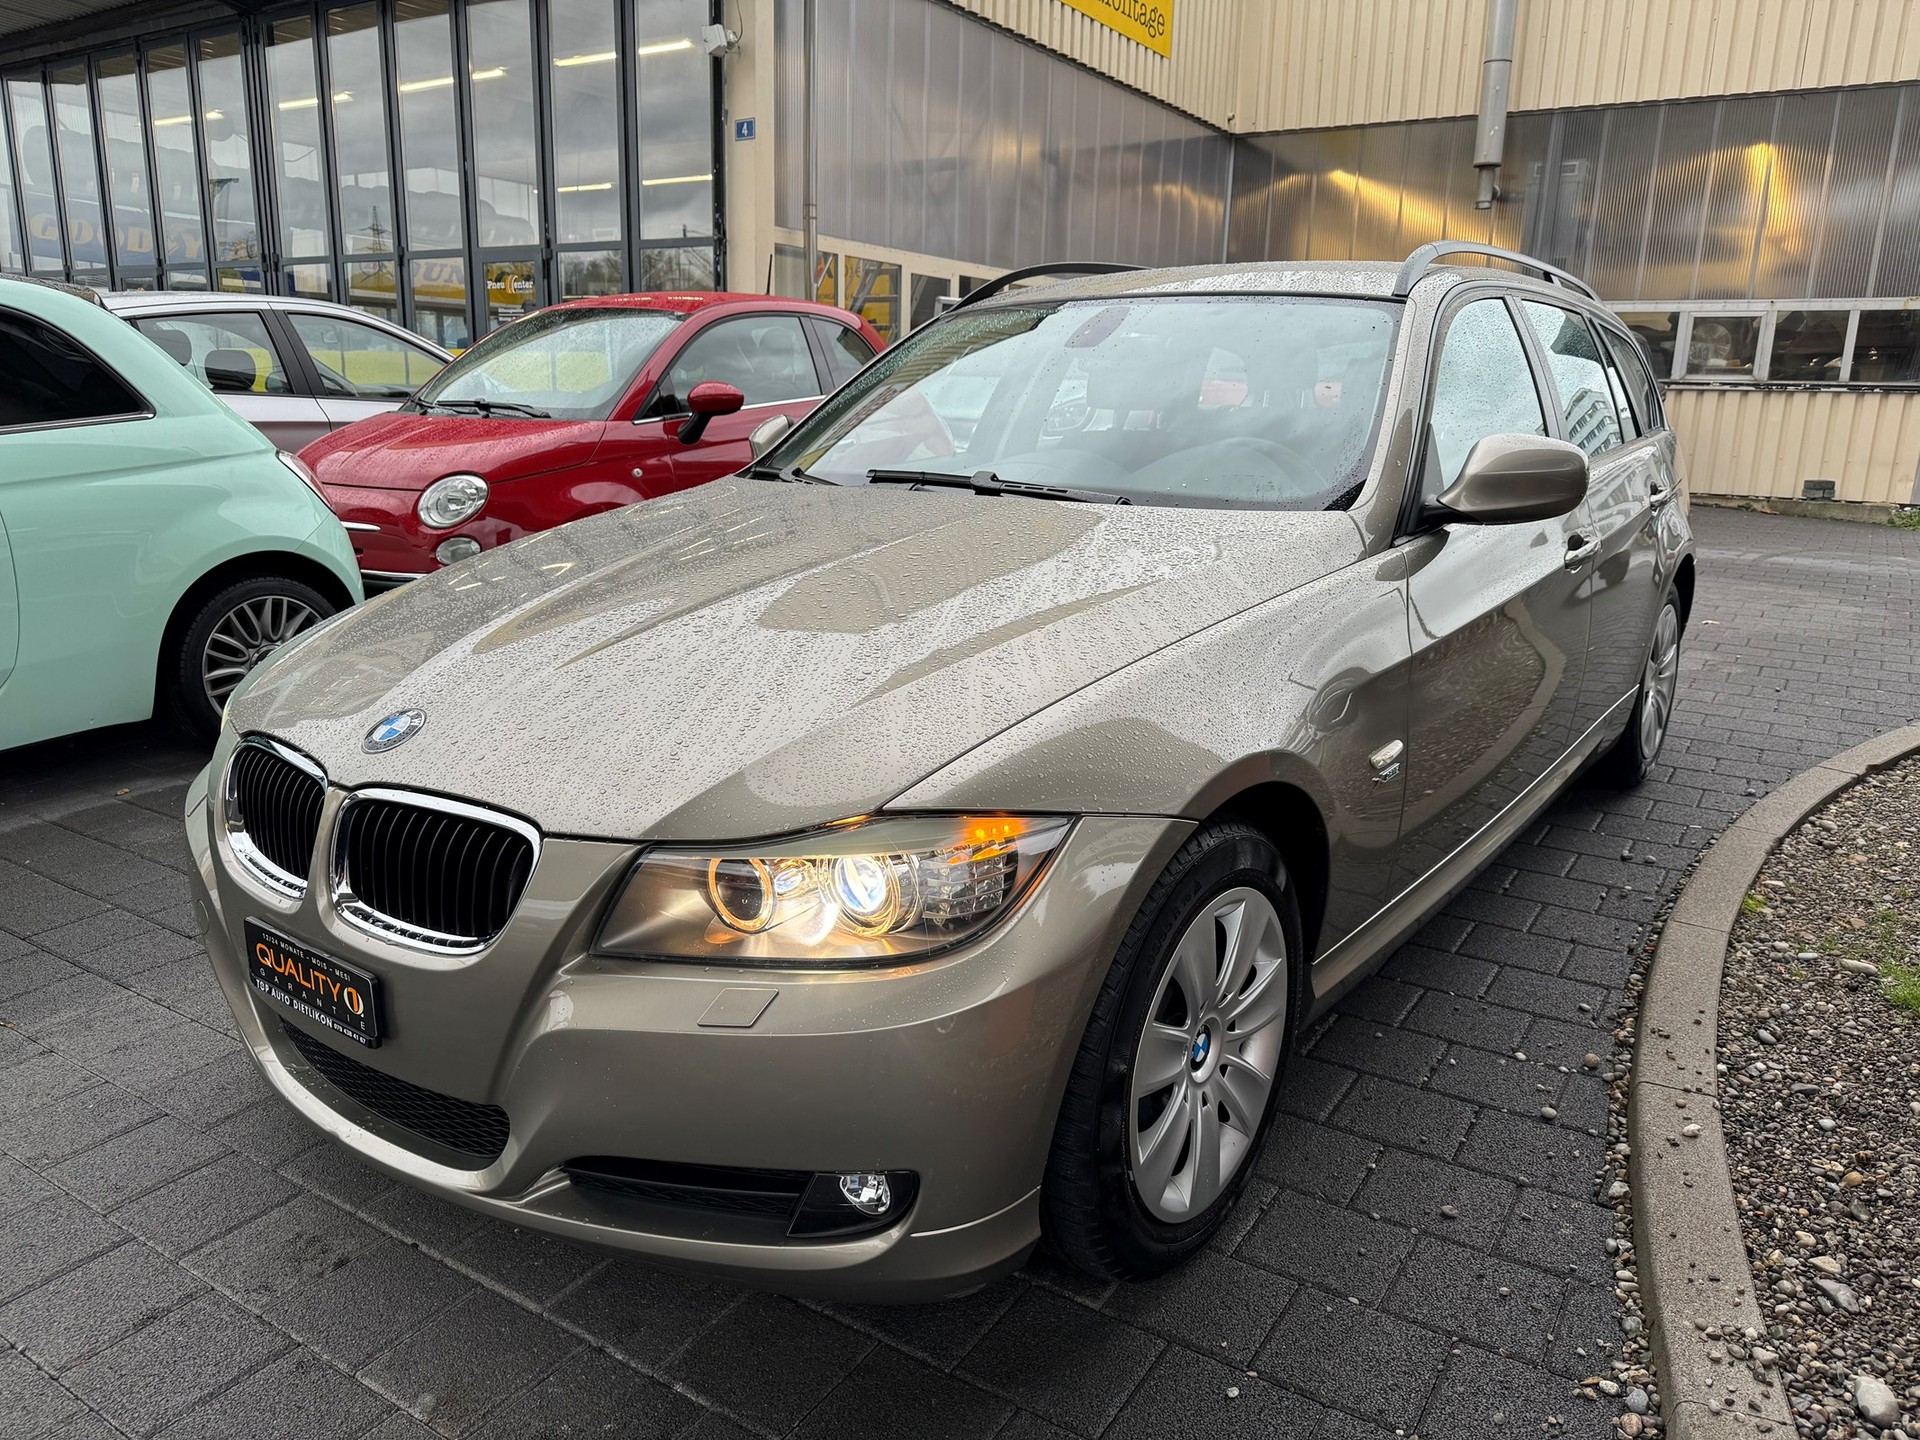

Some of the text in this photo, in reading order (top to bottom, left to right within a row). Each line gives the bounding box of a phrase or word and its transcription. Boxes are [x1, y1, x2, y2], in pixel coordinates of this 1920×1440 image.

[742, 122, 748, 136] 4
[487, 280, 505, 289] Pneu
[256, 943, 340, 1002] QUALITY
[280, 941, 304, 958] MONATE
[311, 957, 327, 970] MOIS
[334, 969, 351, 982] MESI
[256, 979, 270, 993] TOP
[271, 989, 290, 1005] AUTO
[293, 1000, 333, 1029] DIETLIKON
[260, 968, 366, 1031] GARANTIE
